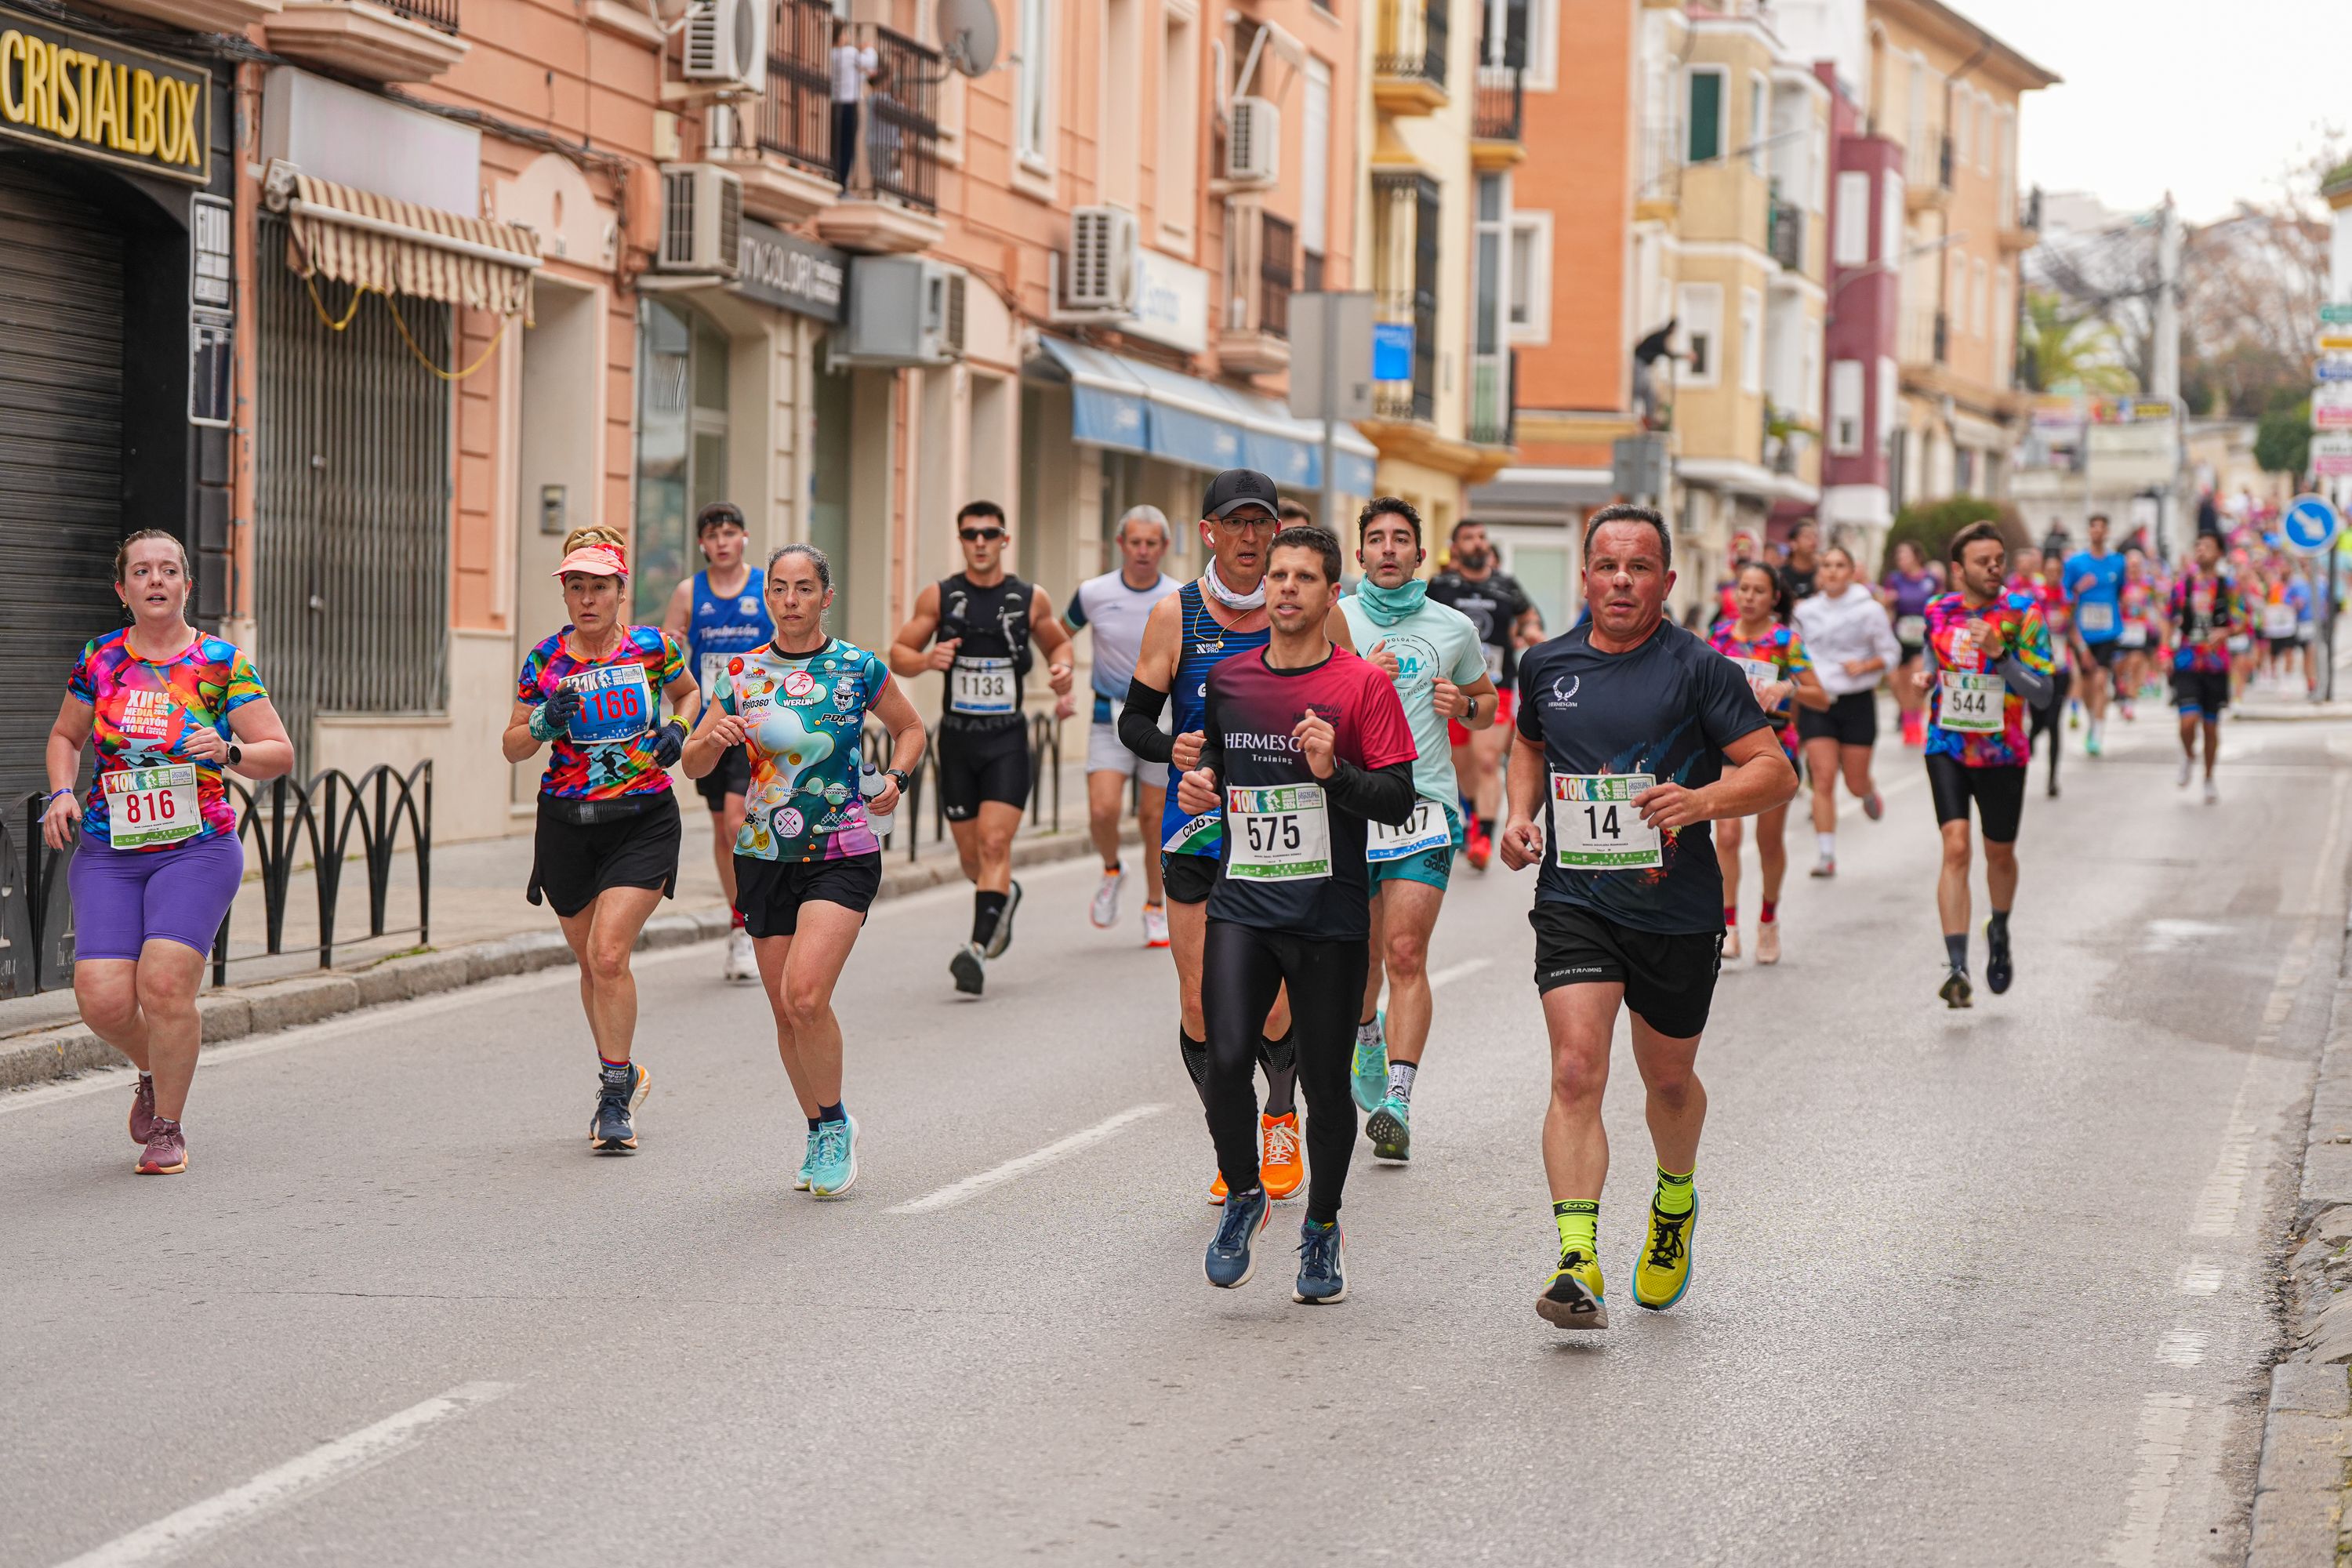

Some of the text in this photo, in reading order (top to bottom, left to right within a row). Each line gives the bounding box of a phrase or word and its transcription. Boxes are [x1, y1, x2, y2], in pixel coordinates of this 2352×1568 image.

[0, 29, 201, 167] CRISTALBOX
[961, 676, 1004, 696] 1133
[126, 690, 154, 708] XII
[155, 692, 170, 704] 08
[578, 688, 639, 724] 1166
[782, 698, 814, 706] WERUN
[1952, 690, 1986, 713] 544
[121, 716, 168, 728] MARATÓN
[124, 707, 153, 717] MEDIA
[821, 713, 847, 722] PDA
[125, 724, 145, 734] 10K
[1225, 732, 1287, 751] HERMES
[1252, 753, 1293, 764] Training
[111, 771, 139, 792] 10K
[1560, 779, 1589, 800] 10K
[126, 789, 176, 823] 816
[1233, 790, 1260, 812] 10K
[1183, 818, 1206, 838] Club
[1584, 805, 1621, 840] 14
[1247, 815, 1300, 851] 575
